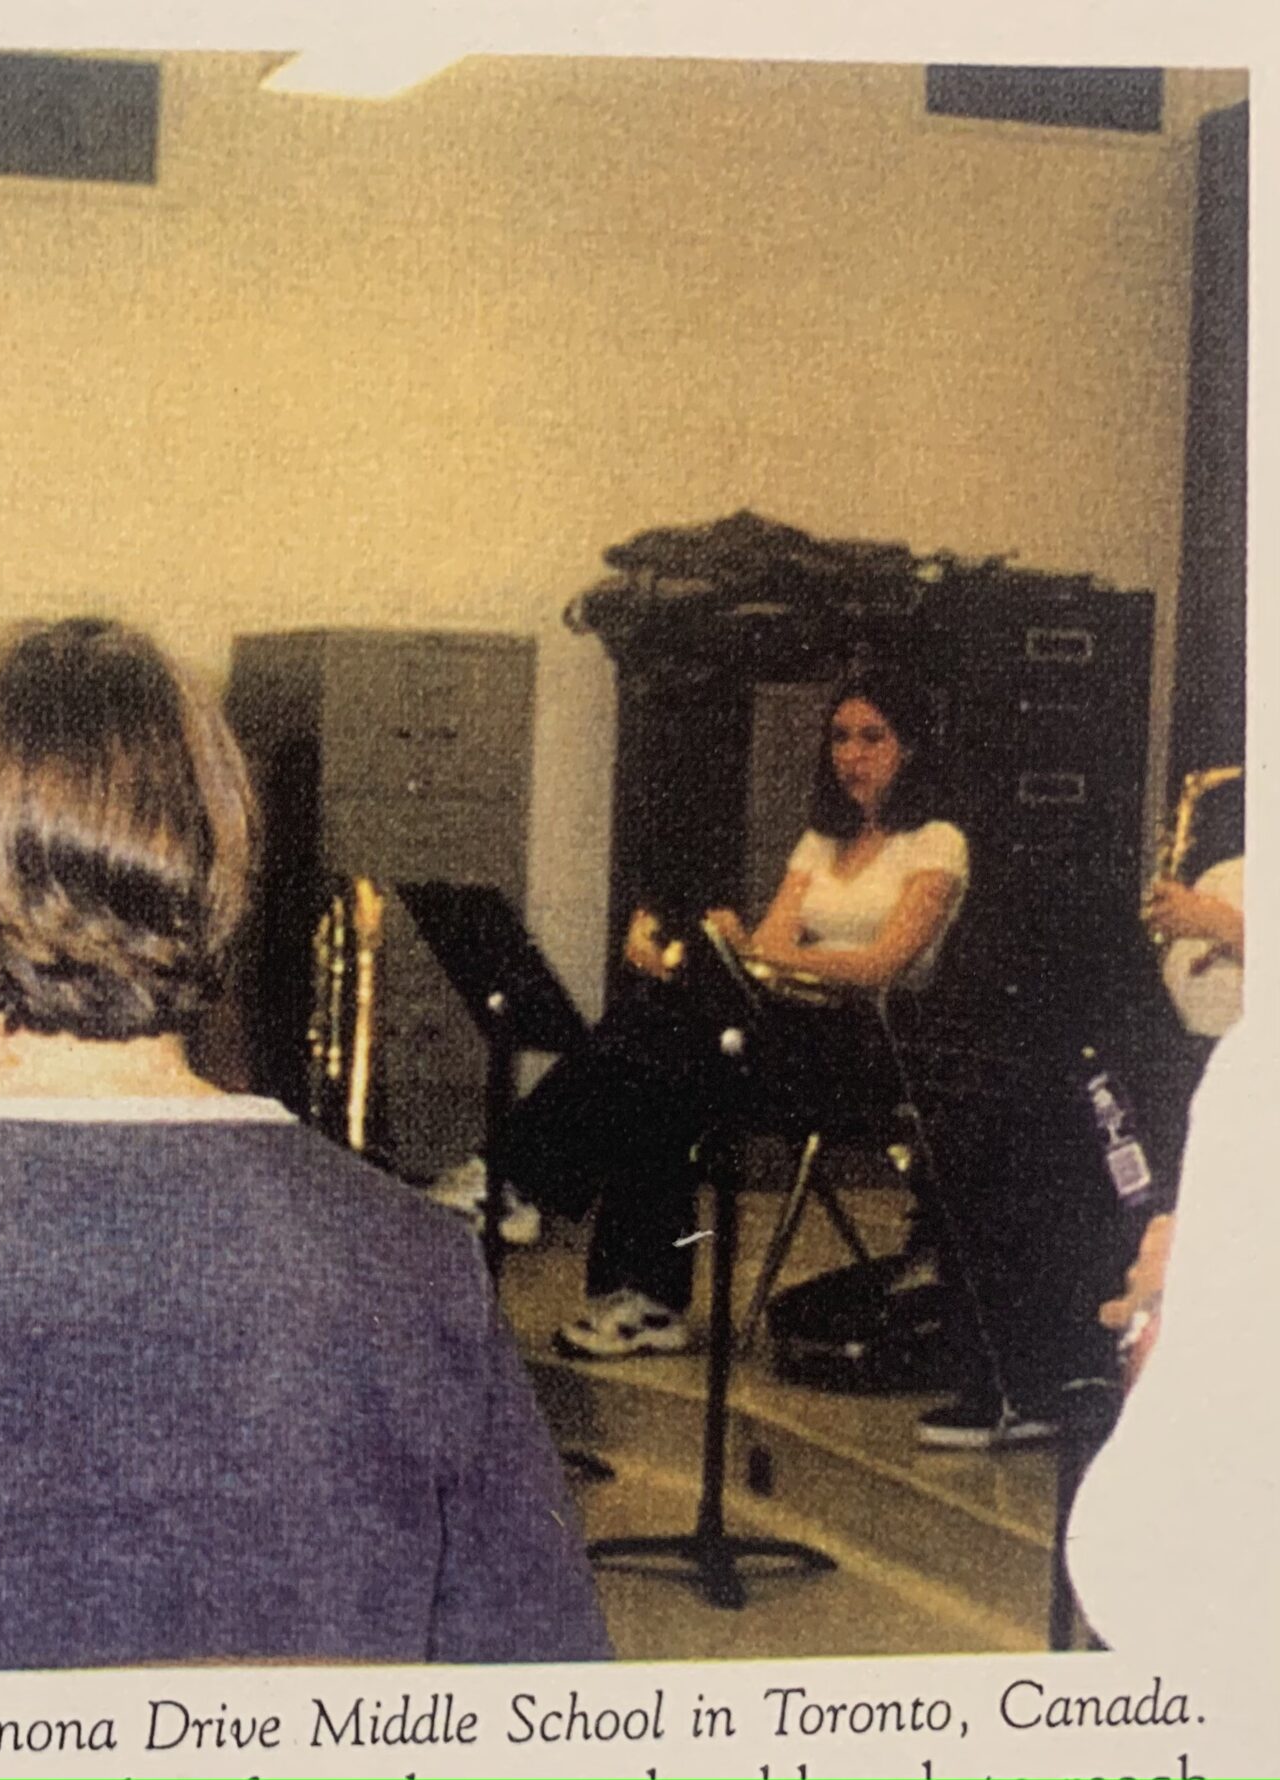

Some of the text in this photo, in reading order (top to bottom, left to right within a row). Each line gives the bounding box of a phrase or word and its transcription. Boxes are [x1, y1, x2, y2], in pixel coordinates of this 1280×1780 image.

[145, 1700, 281, 1751] Drive
[310, 1693, 478, 1747] Middle
[507, 1689, 664, 1744] School
[692, 1694, 736, 1739] in
[764, 1686, 969, 1738] Toronto,
[1000, 1676, 1206, 1729] Canada.
